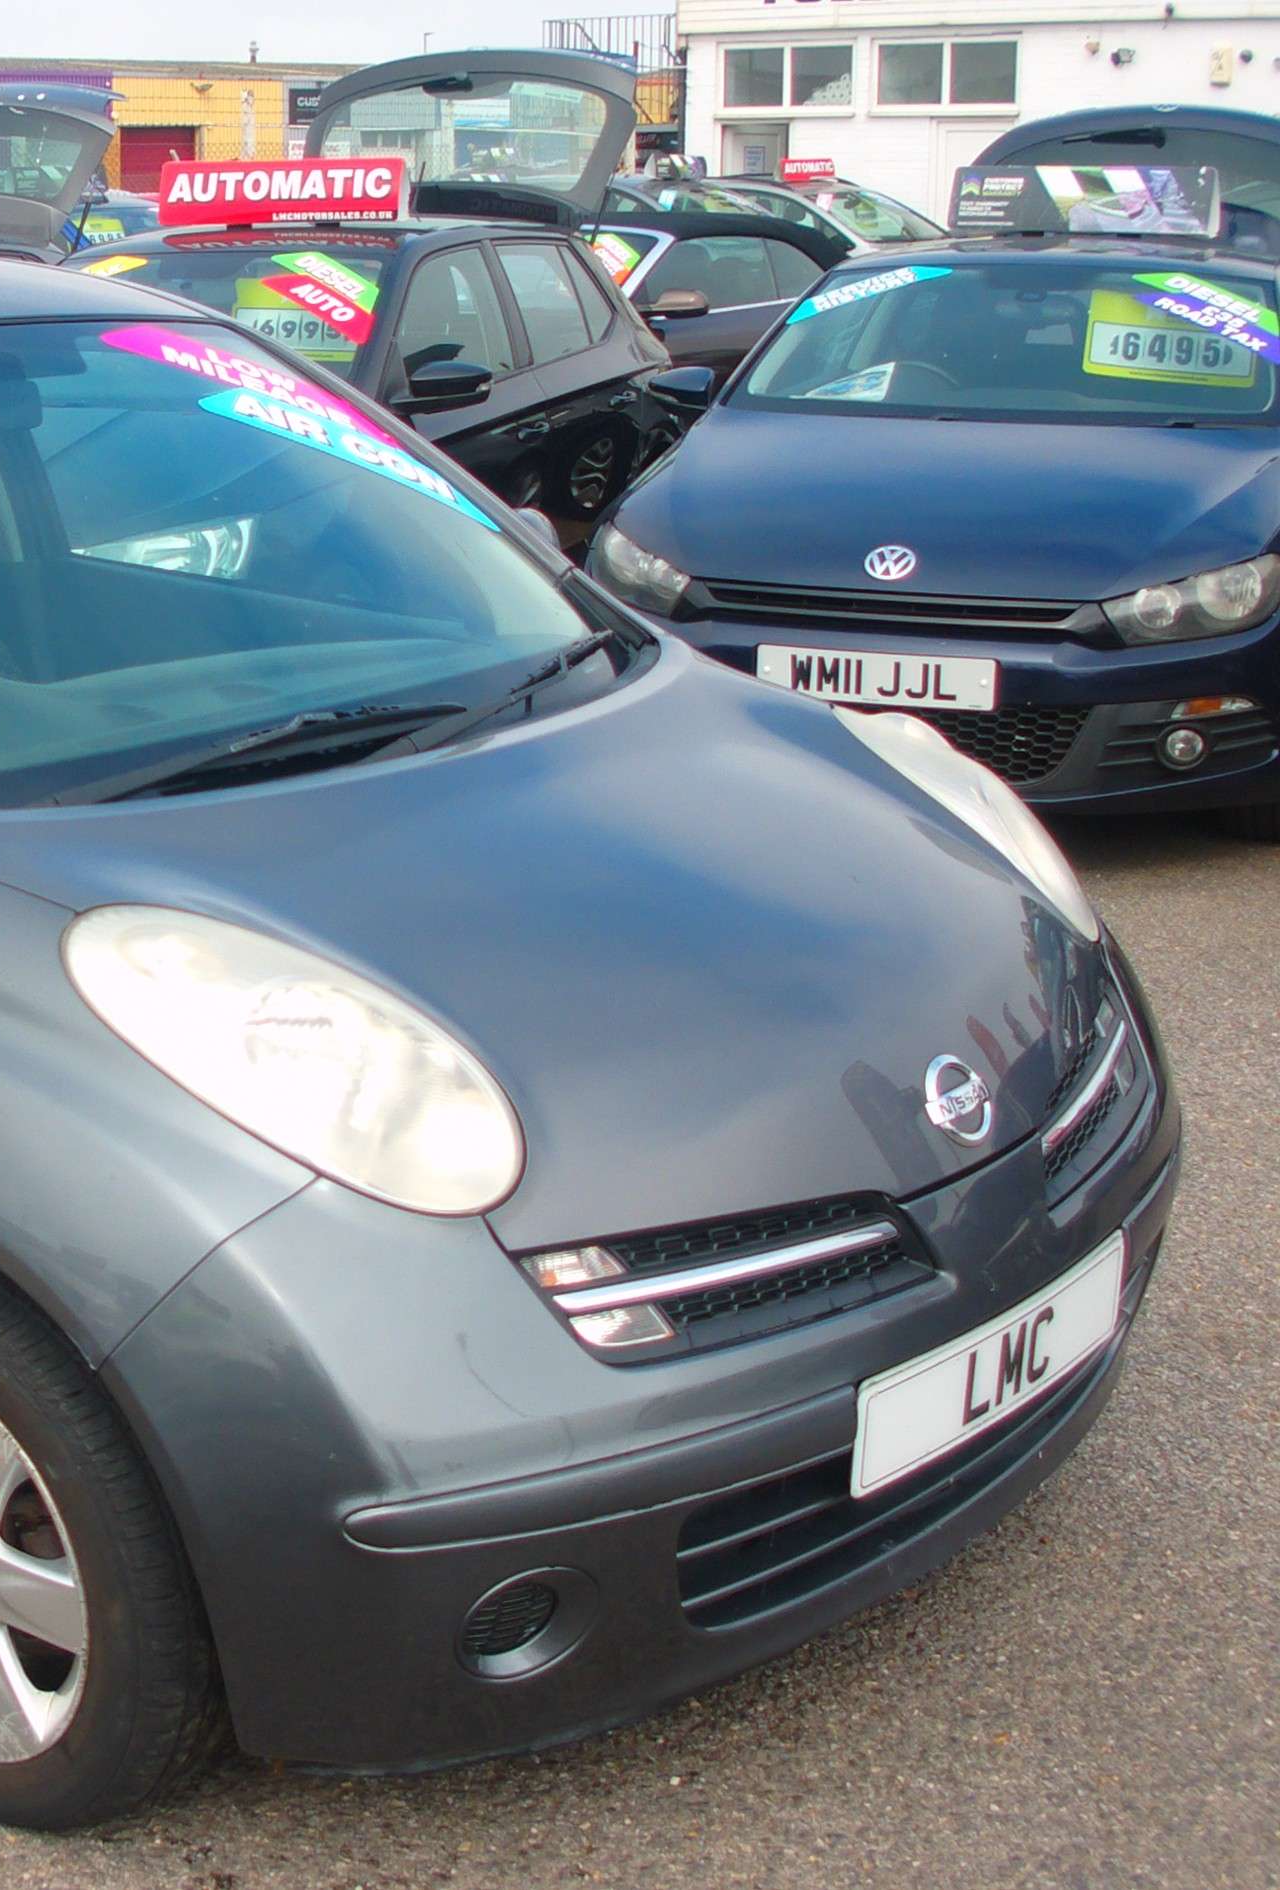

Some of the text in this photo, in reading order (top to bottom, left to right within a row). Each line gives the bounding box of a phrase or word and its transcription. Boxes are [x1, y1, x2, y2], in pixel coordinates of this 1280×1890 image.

[297, 95, 321, 107] CUS
[167, 167, 393, 203] AUTOMATIC
[784, 161, 834, 174] AUTOMATIC
[294, 255, 365, 300] DIESEL
[1164, 276, 1260, 323] DIESEL
[289, 283, 356, 322] AUTO
[1154, 297, 1268, 352] ROAD TAX
[204, 347, 296, 392] LOW
[234, 394, 458, 503] AIR CON
[790, 654, 958, 701] WM11 JJL
[962, 1306, 1054, 1426] LMC
